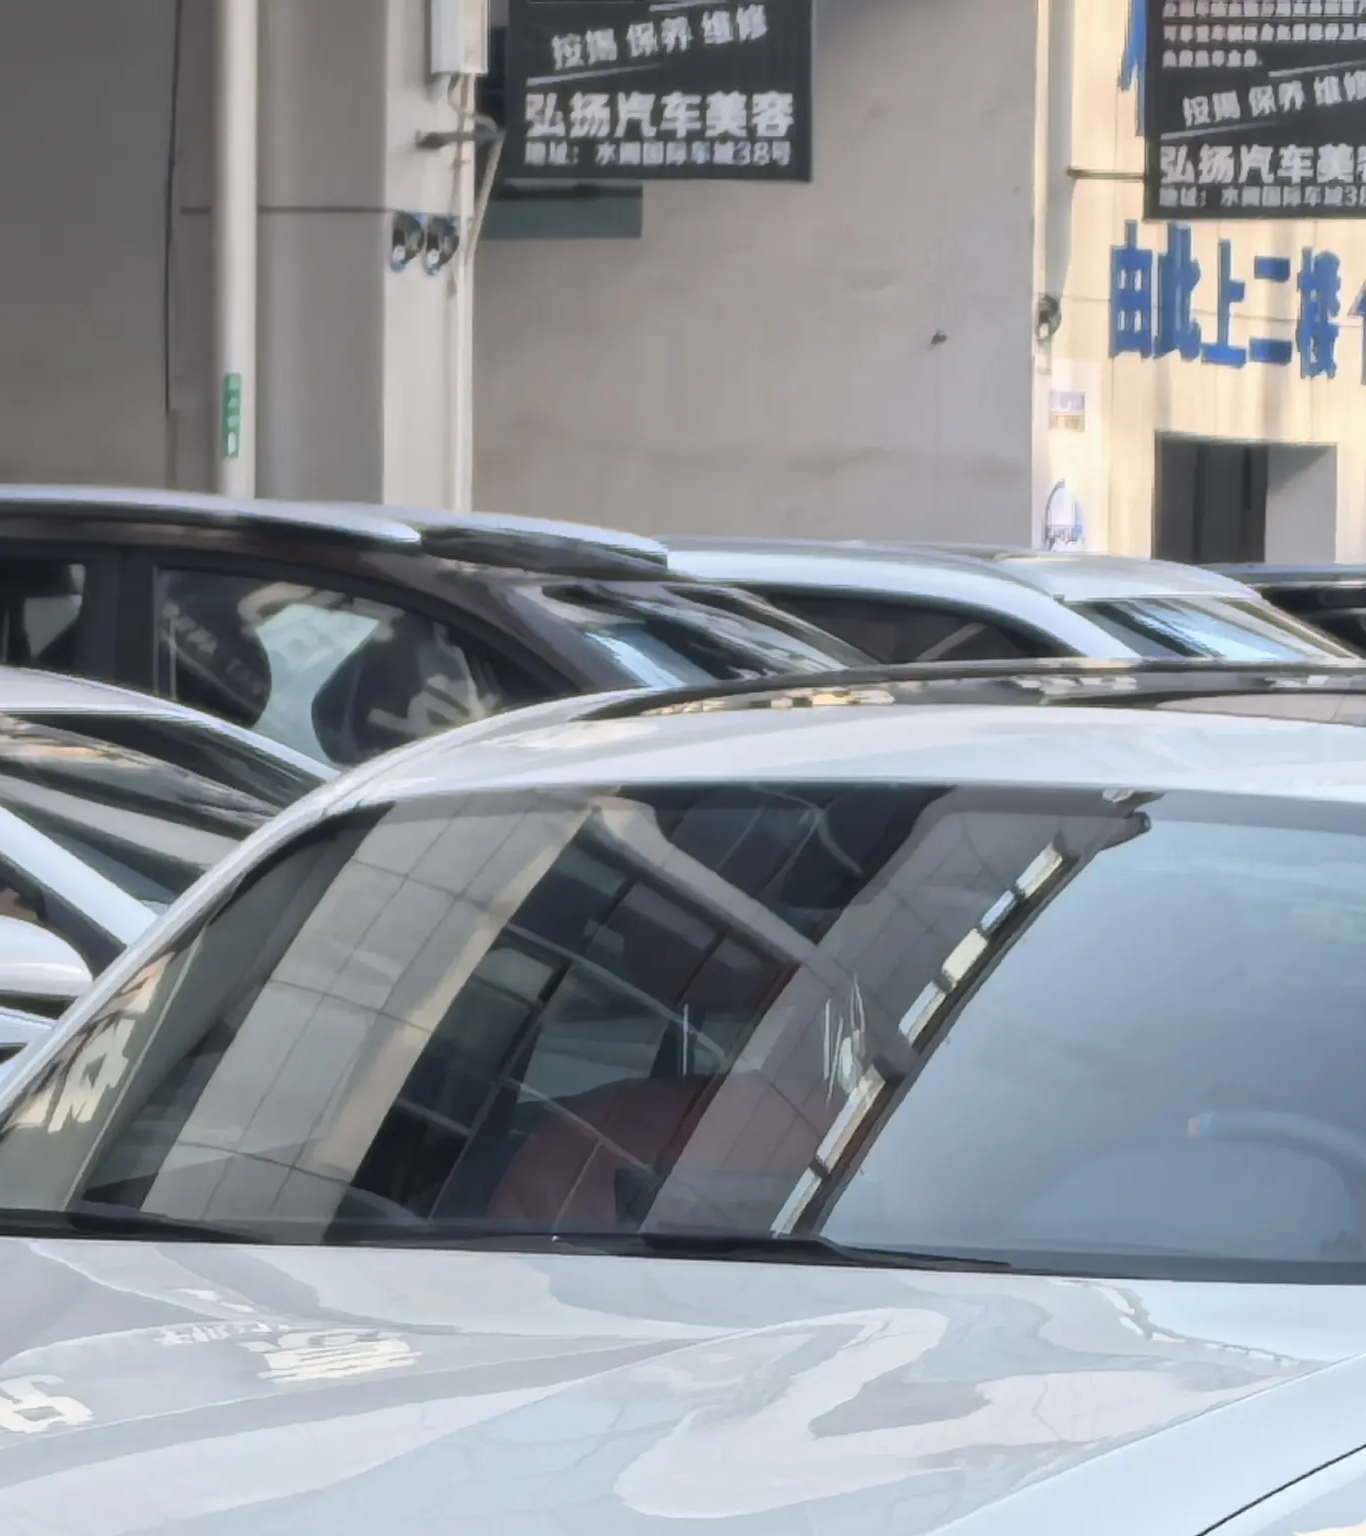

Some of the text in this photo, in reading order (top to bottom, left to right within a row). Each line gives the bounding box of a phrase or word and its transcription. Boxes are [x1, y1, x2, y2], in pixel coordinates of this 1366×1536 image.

[525, 91, 795, 138] 弘扬汽车美容
